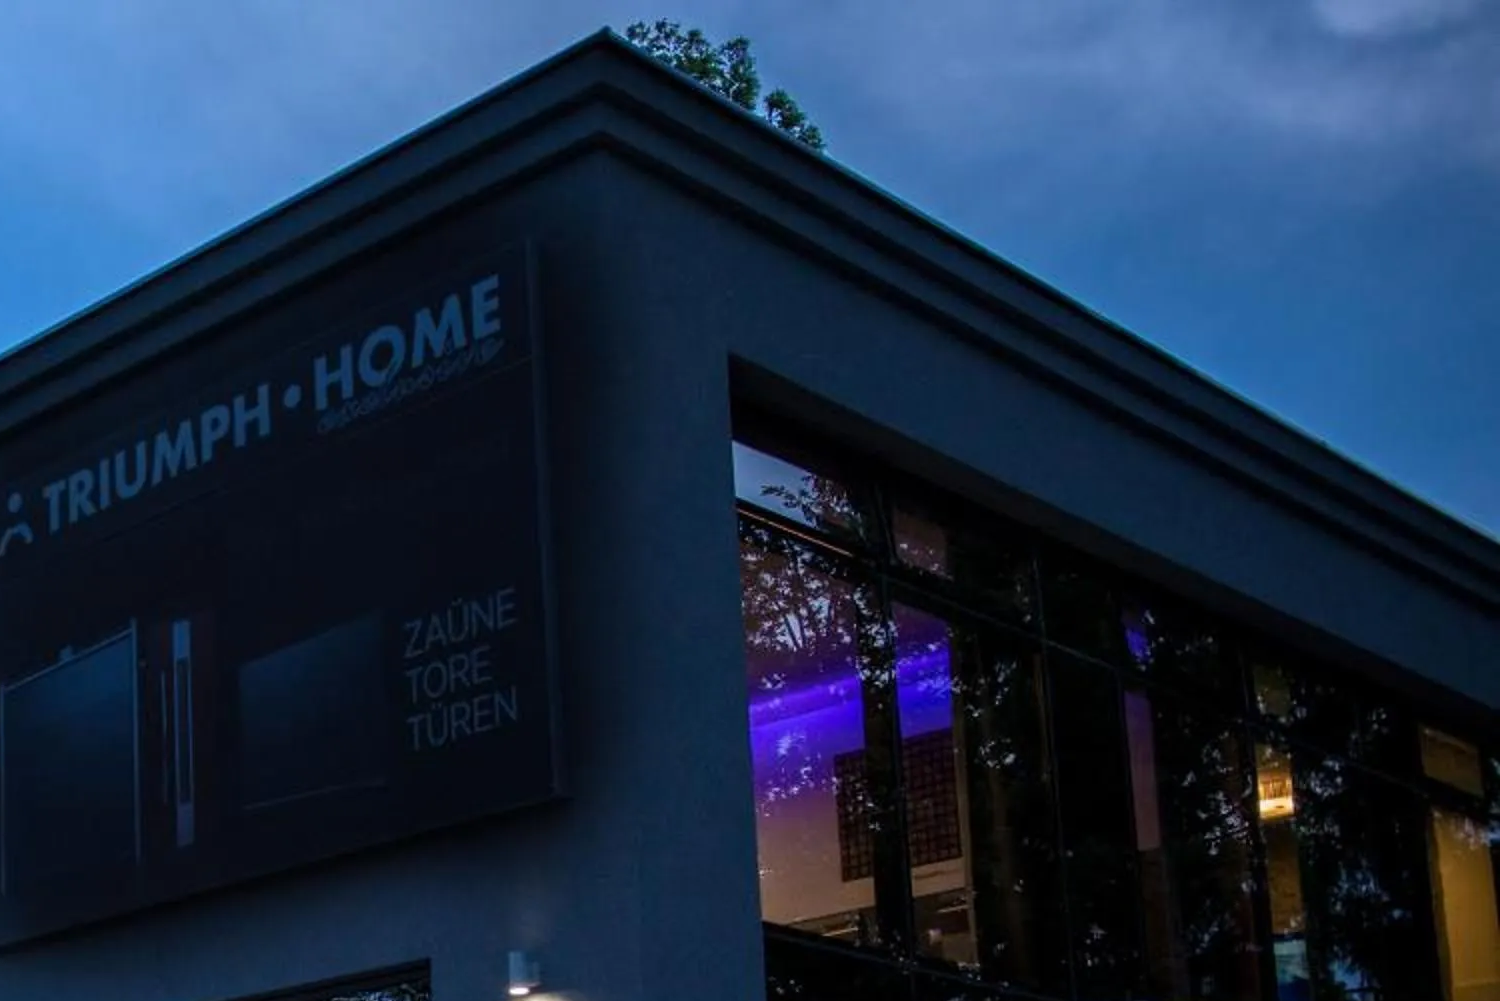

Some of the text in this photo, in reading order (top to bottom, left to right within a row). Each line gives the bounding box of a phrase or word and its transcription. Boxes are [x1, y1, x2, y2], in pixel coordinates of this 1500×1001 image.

[41, 382, 273, 536] TRIUMPH
[312, 272, 503, 411] HOME
[403, 643, 493, 705] TORE
[405, 685, 518, 752] TÜREN
